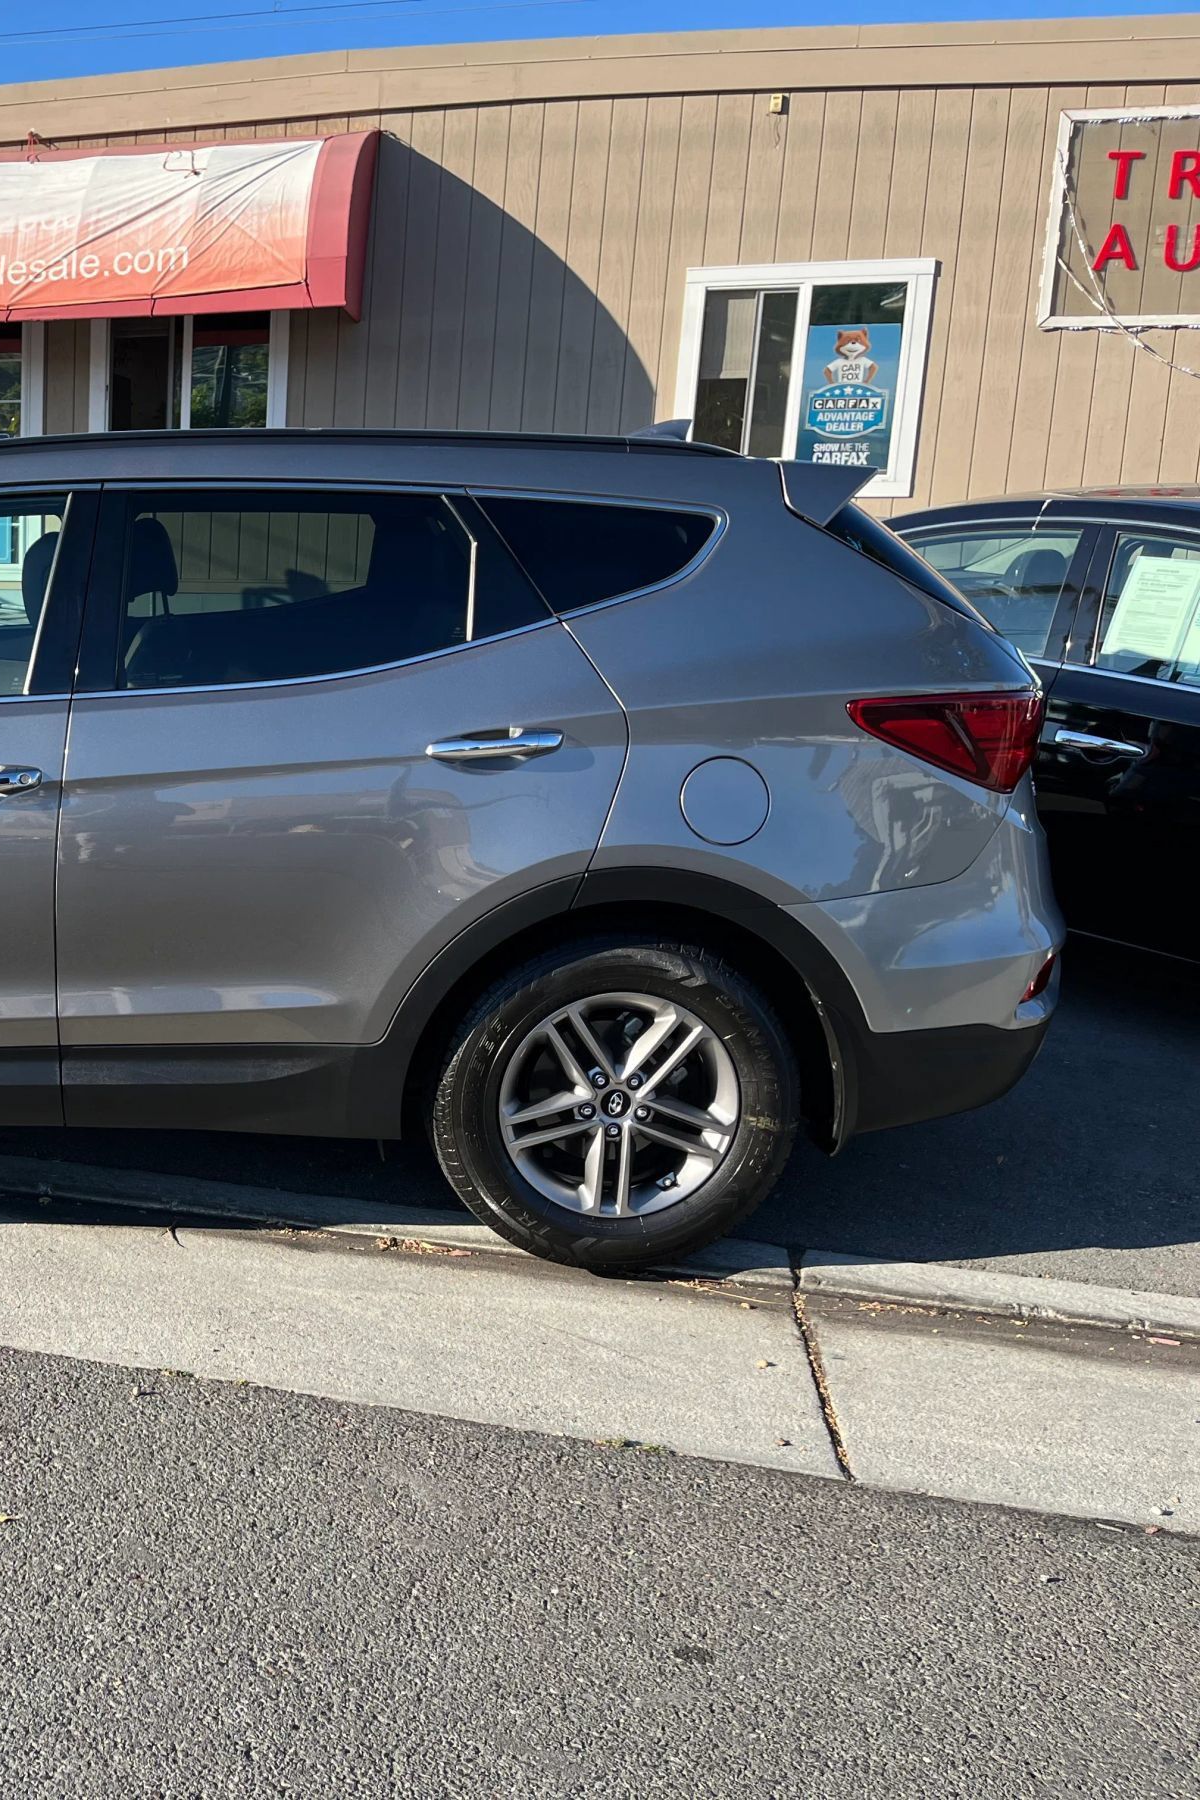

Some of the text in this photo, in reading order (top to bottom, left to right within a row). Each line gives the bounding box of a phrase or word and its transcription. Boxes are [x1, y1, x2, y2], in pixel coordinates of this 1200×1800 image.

[841, 364, 861, 372] CAR
[841, 373, 860, 381] FOX
[814, 399, 880, 410] CARFAX
[816, 411, 875, 422] ADVANTAGE
[825, 422, 864, 432] DEALER
[813, 442, 870, 452] SHOW ME THE
[812, 452, 870, 465] CARFAX
